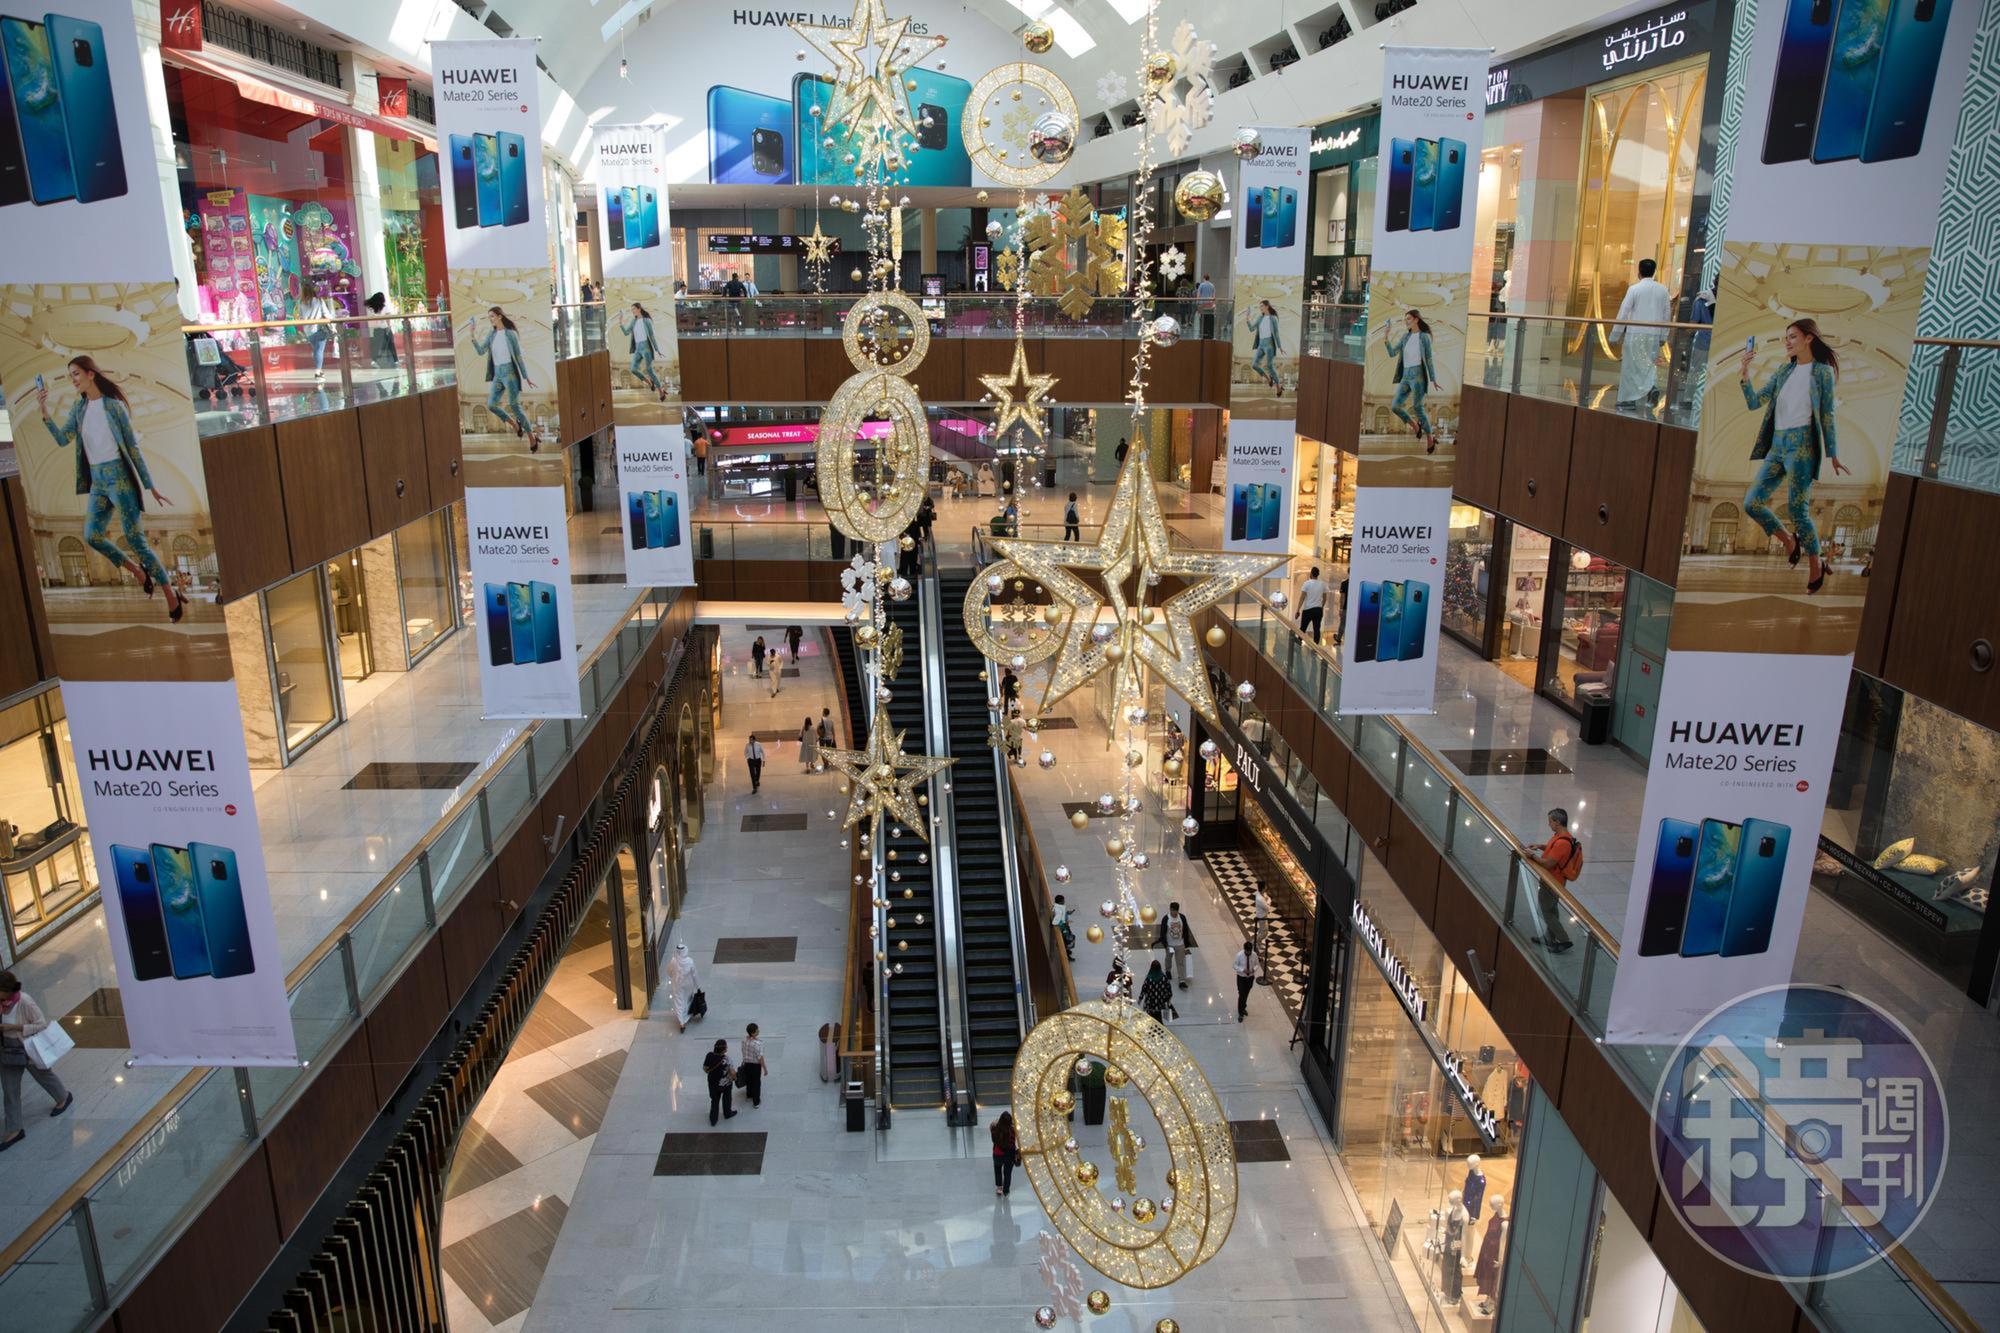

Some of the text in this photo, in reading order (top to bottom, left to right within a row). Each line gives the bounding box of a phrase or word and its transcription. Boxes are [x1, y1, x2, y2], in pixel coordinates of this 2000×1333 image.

[1602, 28, 1685, 70] ماترنتي
[442, 68, 517, 84] HUAWEI
[1393, 74, 1468, 91] HUAWEI
[443, 89, 518, 102] Mate20 Series
[1391, 95, 1466, 108] Mate20 Series
[600, 143, 652, 155] HUAWEI
[1255, 146, 1297, 157] UAWEI
[1276, 159, 1296, 167] Series
[747, 430, 801, 440] SEASONAL TREAT
[623, 452, 673, 462] HUAWEI
[1233, 446, 1282, 456] HUAWEI
[624, 464, 674, 473] Mate20 Series
[1232, 458, 1280, 466] Mate20 Series
[477, 526, 549, 540] HUAWEI
[1361, 526, 1432, 539] HUAWEI
[478, 544, 550, 555] Mate20 Series
[1360, 543, 1430, 554] Mate20 Series
[1669, 720, 1804, 747] HUAWEI
[88, 749, 215, 771] HUAWEI
[1665, 752, 1797, 773] Mate20 Series
[1236, 743, 1261, 793] PAUL
[93, 780, 219, 797] Mate20 Series
[1353, 899, 1424, 1021] KAREN MILLEN
